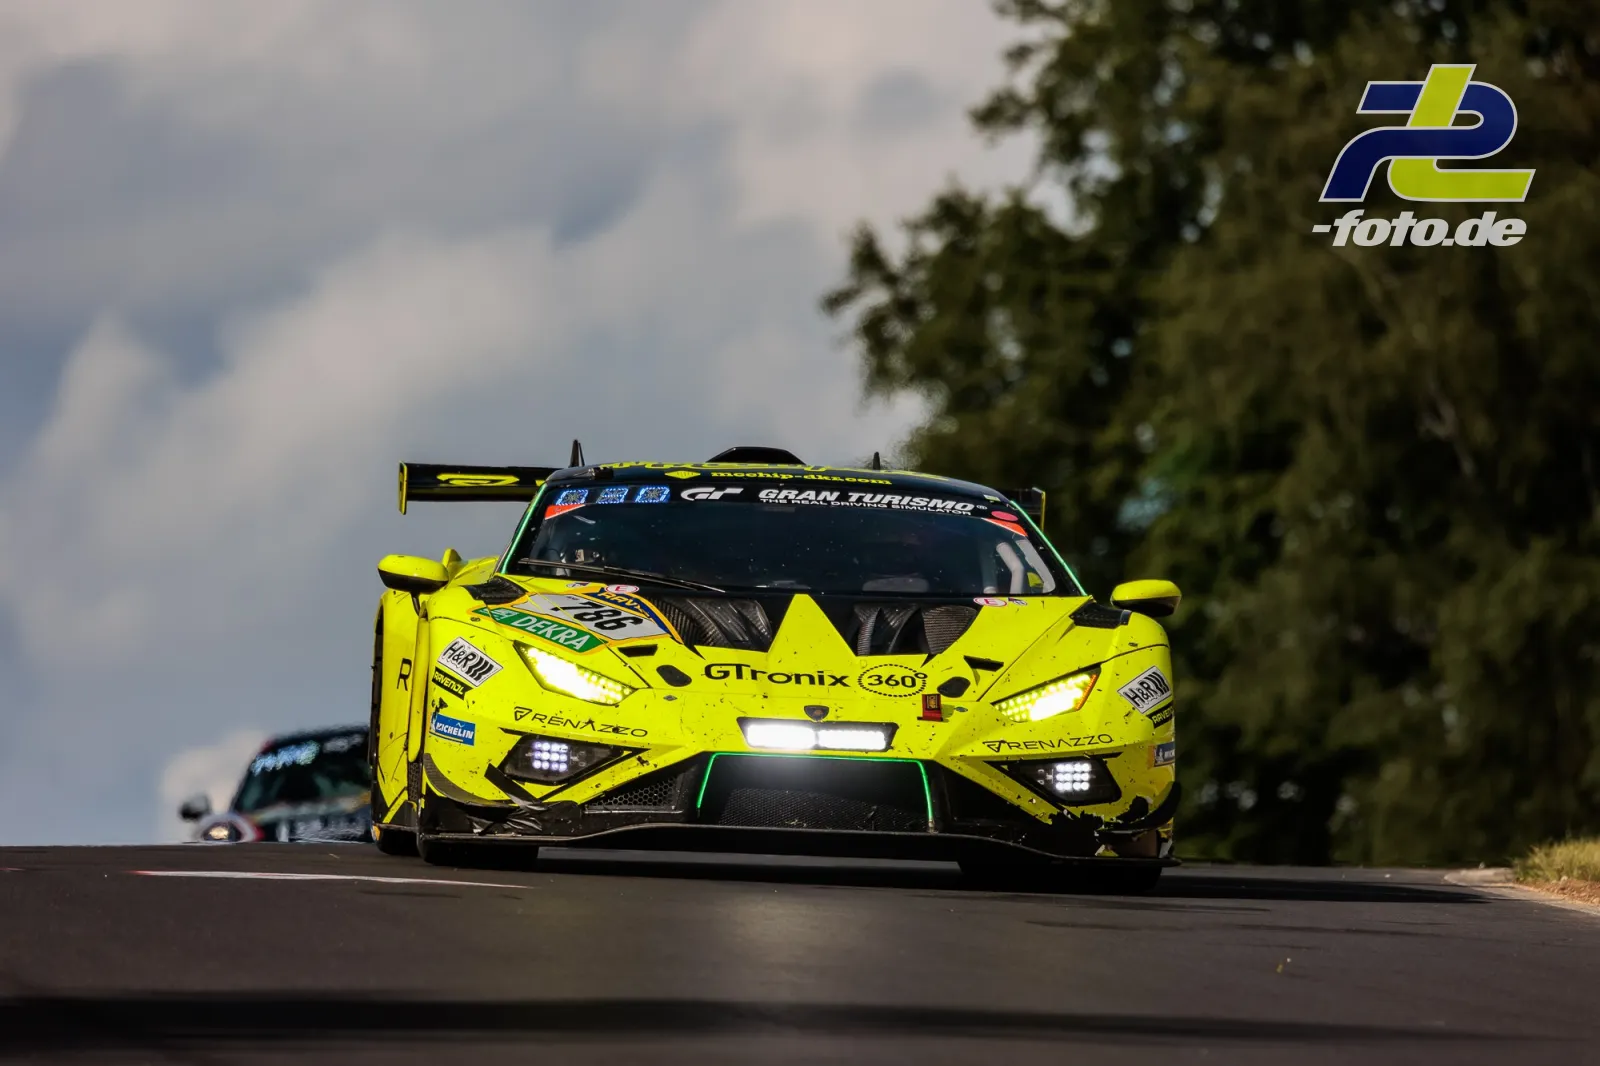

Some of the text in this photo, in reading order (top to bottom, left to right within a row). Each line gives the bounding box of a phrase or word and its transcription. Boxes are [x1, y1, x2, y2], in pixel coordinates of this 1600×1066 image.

[758, 488, 840, 501] GRAN
[848, 491, 976, 512] TURISMO
[891, 504, 972, 516] SIMULATOR
[550, 601, 644, 630] 786
[511, 616, 590, 650] DEKRA
[433, 671, 465, 695] RAVENOL
[703, 663, 852, 688] GTronix
[436, 722, 474, 739] MICHELIN
[531, 713, 648, 737] RENAZZO
[1004, 733, 1114, 751] RENAZZO
